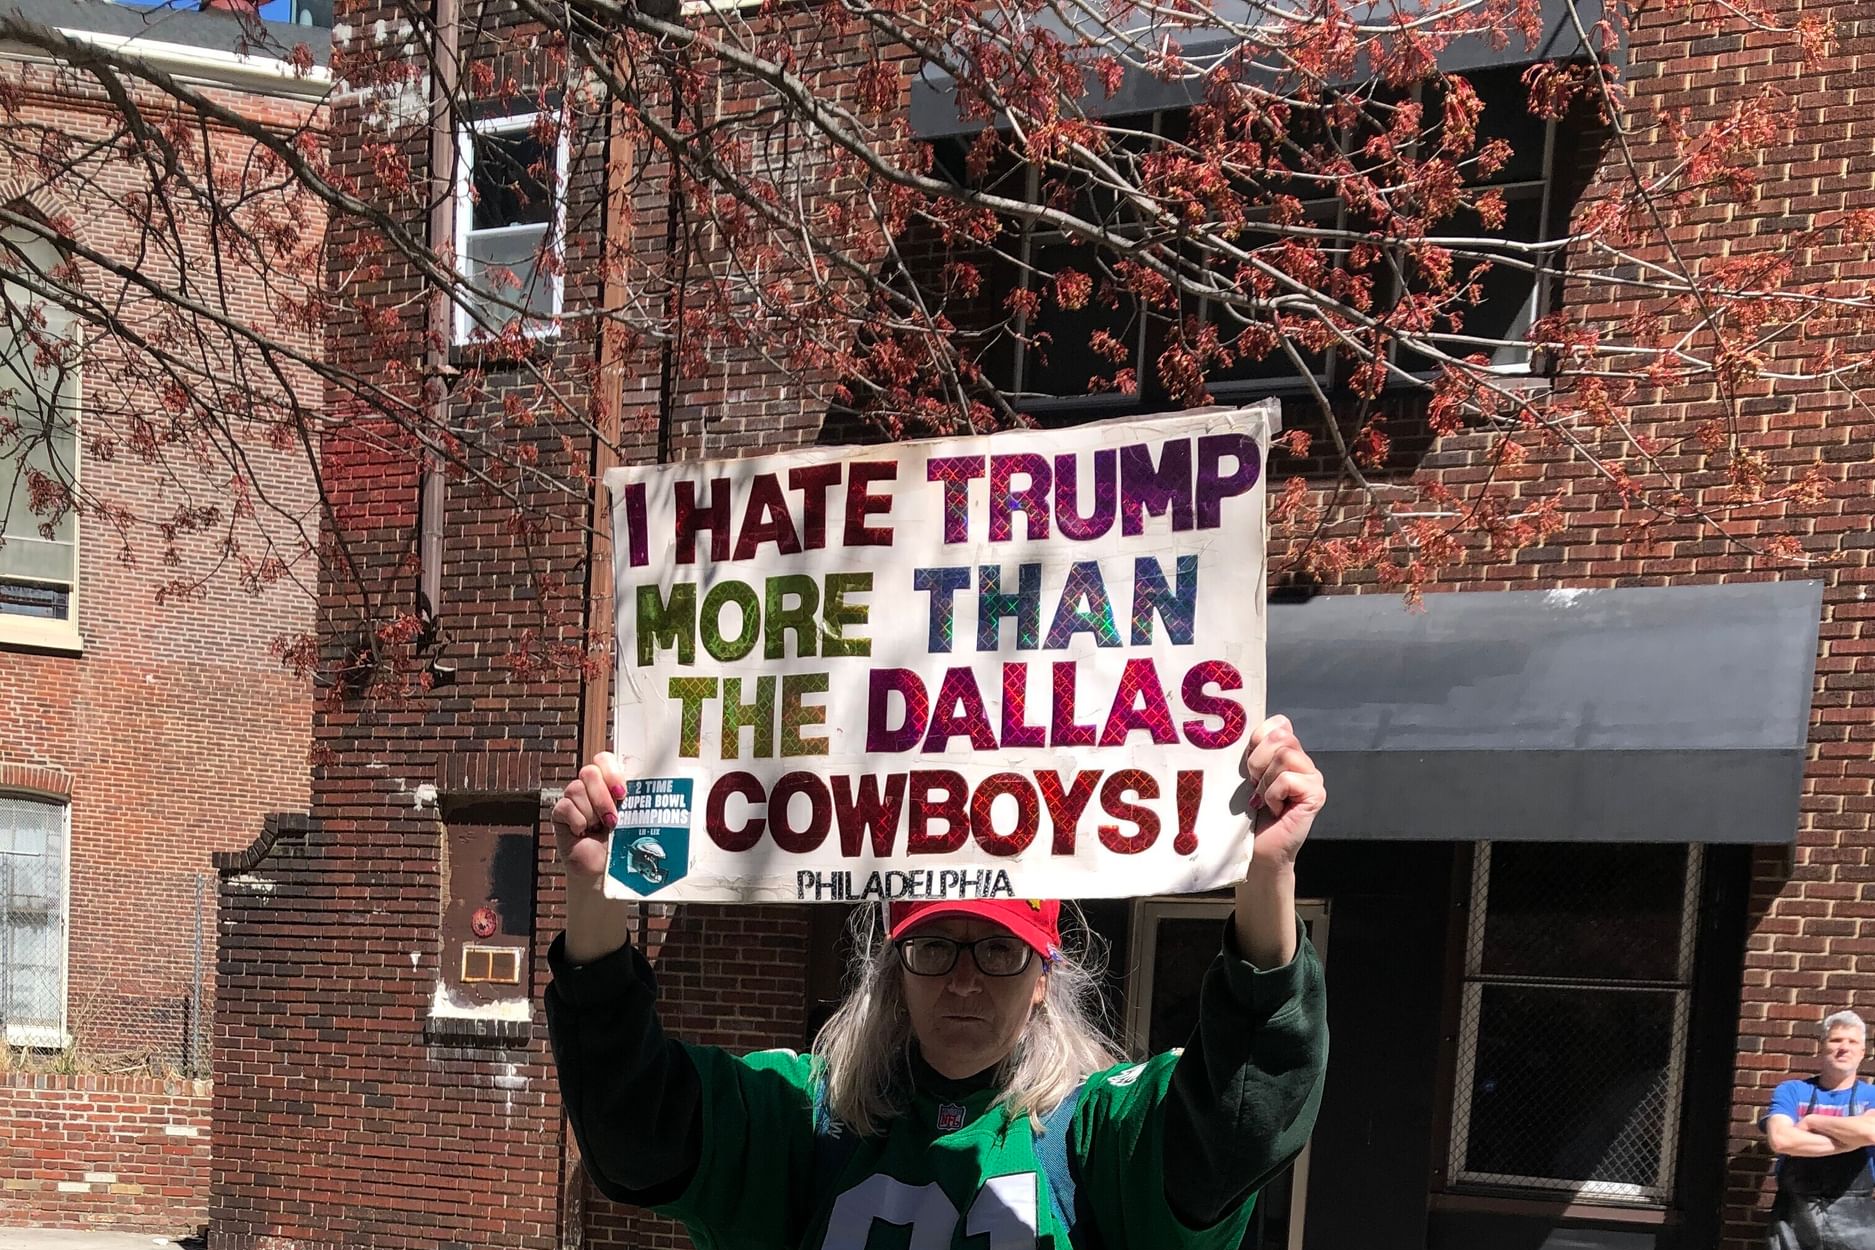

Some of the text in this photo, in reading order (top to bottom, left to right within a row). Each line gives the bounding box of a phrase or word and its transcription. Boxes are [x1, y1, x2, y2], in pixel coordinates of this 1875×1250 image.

[625, 433, 1261, 567] I HATE TRUMP
[635, 555, 1199, 667] MORE THAN
[668, 657, 1247, 760] THE DALLAS
[621, 794, 687, 810] SUPER BOWL
[635, 780, 674, 793] 2 TIME
[706, 769, 1205, 858] COWBOYS!
[618, 809, 689, 826] CHAMPIONS
[796, 869, 1016, 901] PHILADELPHIA
